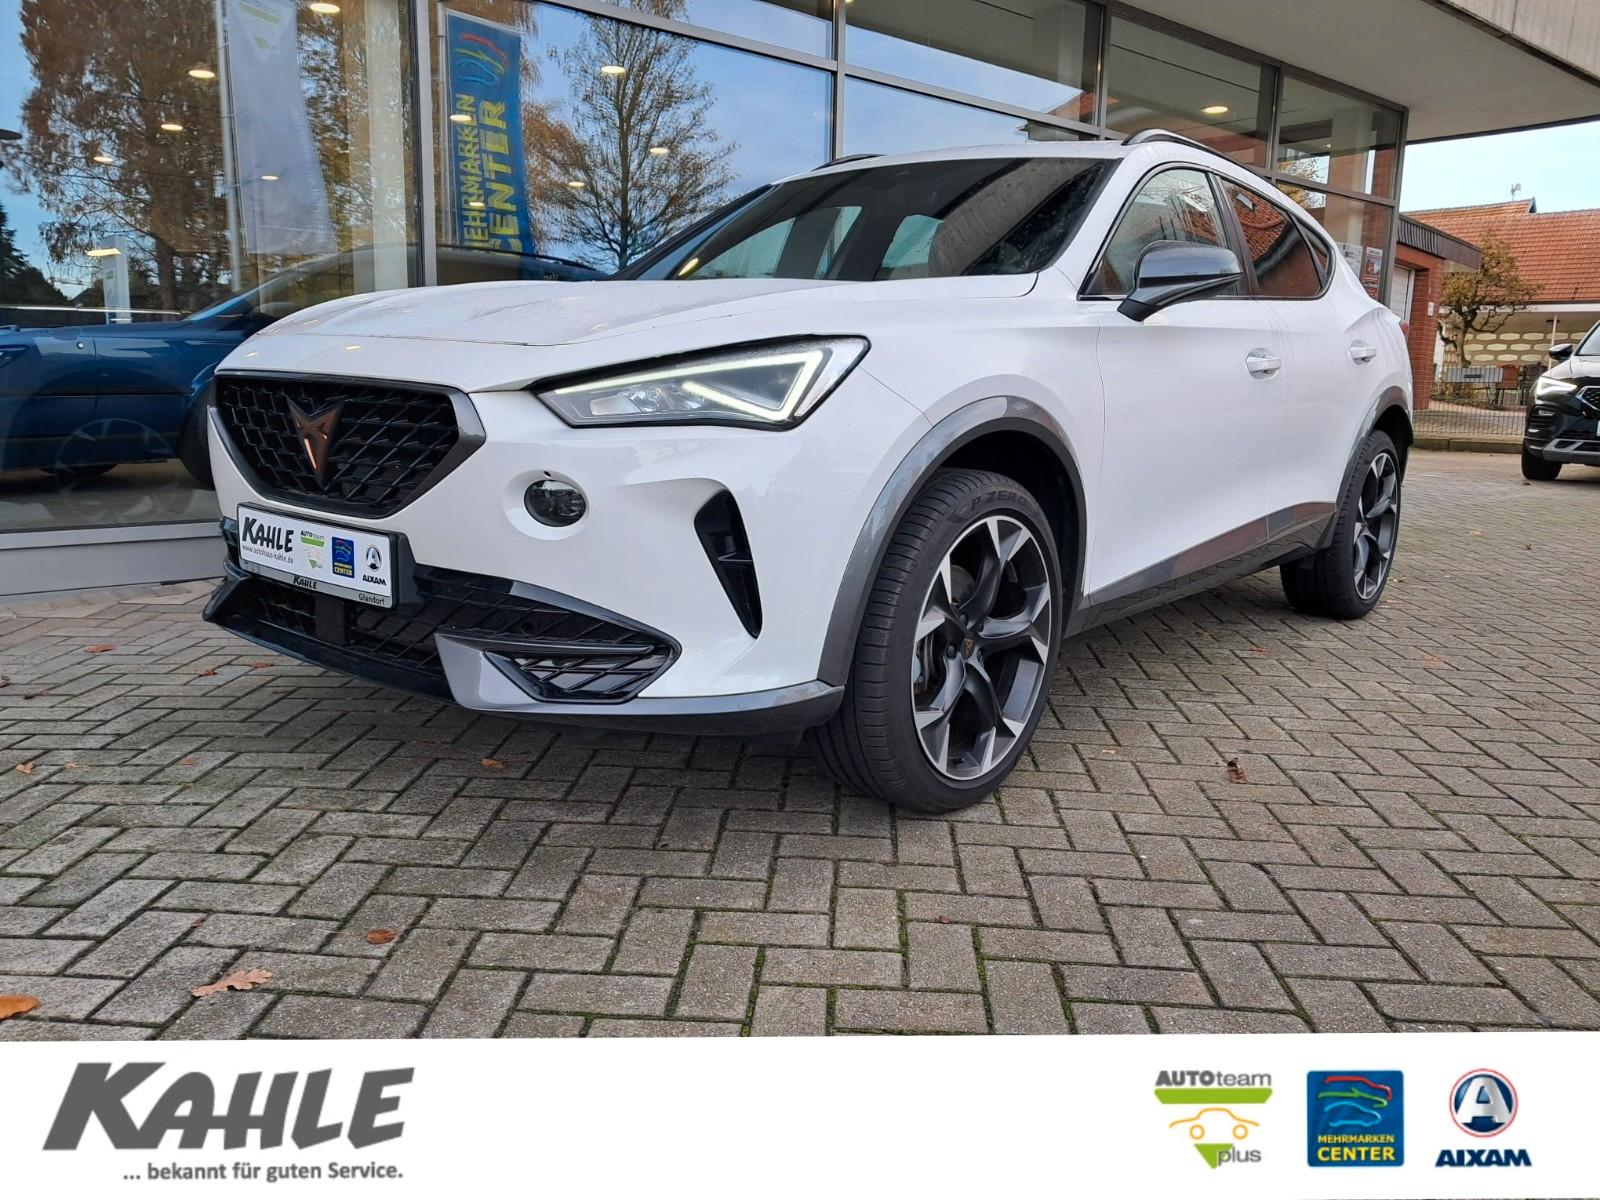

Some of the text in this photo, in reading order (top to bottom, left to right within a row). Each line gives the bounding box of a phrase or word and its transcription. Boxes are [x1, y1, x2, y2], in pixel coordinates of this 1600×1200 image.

[242, 517, 294, 552] KAHLE
[334, 567, 353, 577] CENTER
[294, 577, 317, 589] KAHLE
[362, 575, 386, 586] AIXAM
[358, 593, 385, 605] Glandorf
